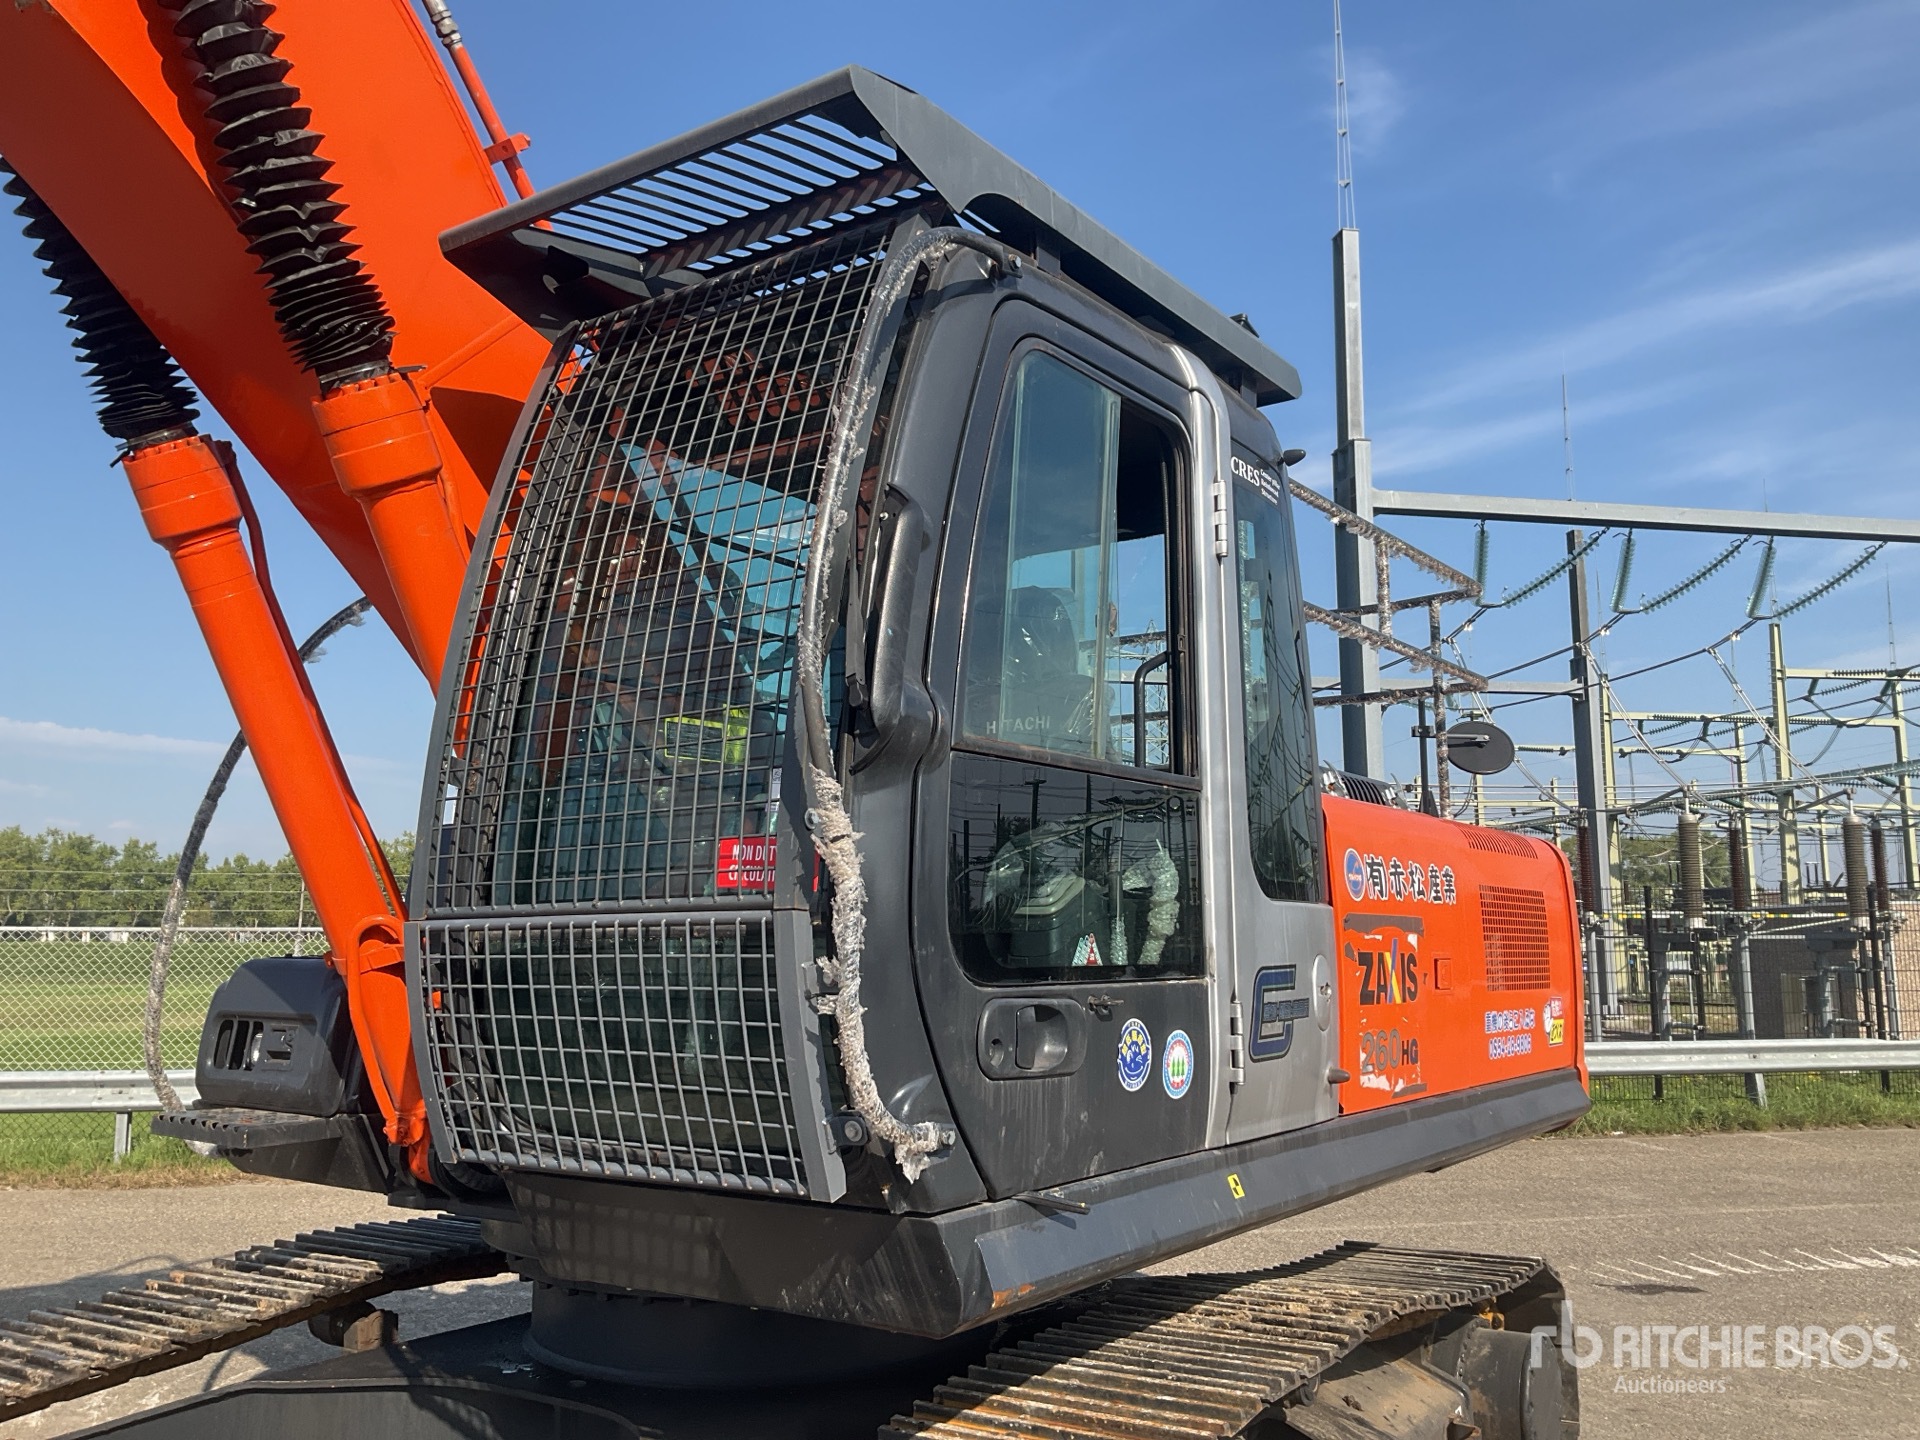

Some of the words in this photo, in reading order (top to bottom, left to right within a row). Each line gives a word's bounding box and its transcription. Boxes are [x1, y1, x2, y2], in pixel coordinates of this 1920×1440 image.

[1230, 456, 1260, 487] CRES
[986, 715, 1051, 735] HITACHI
[732, 844, 753, 861] NON
[1358, 938, 1418, 1005] ZAXIS
